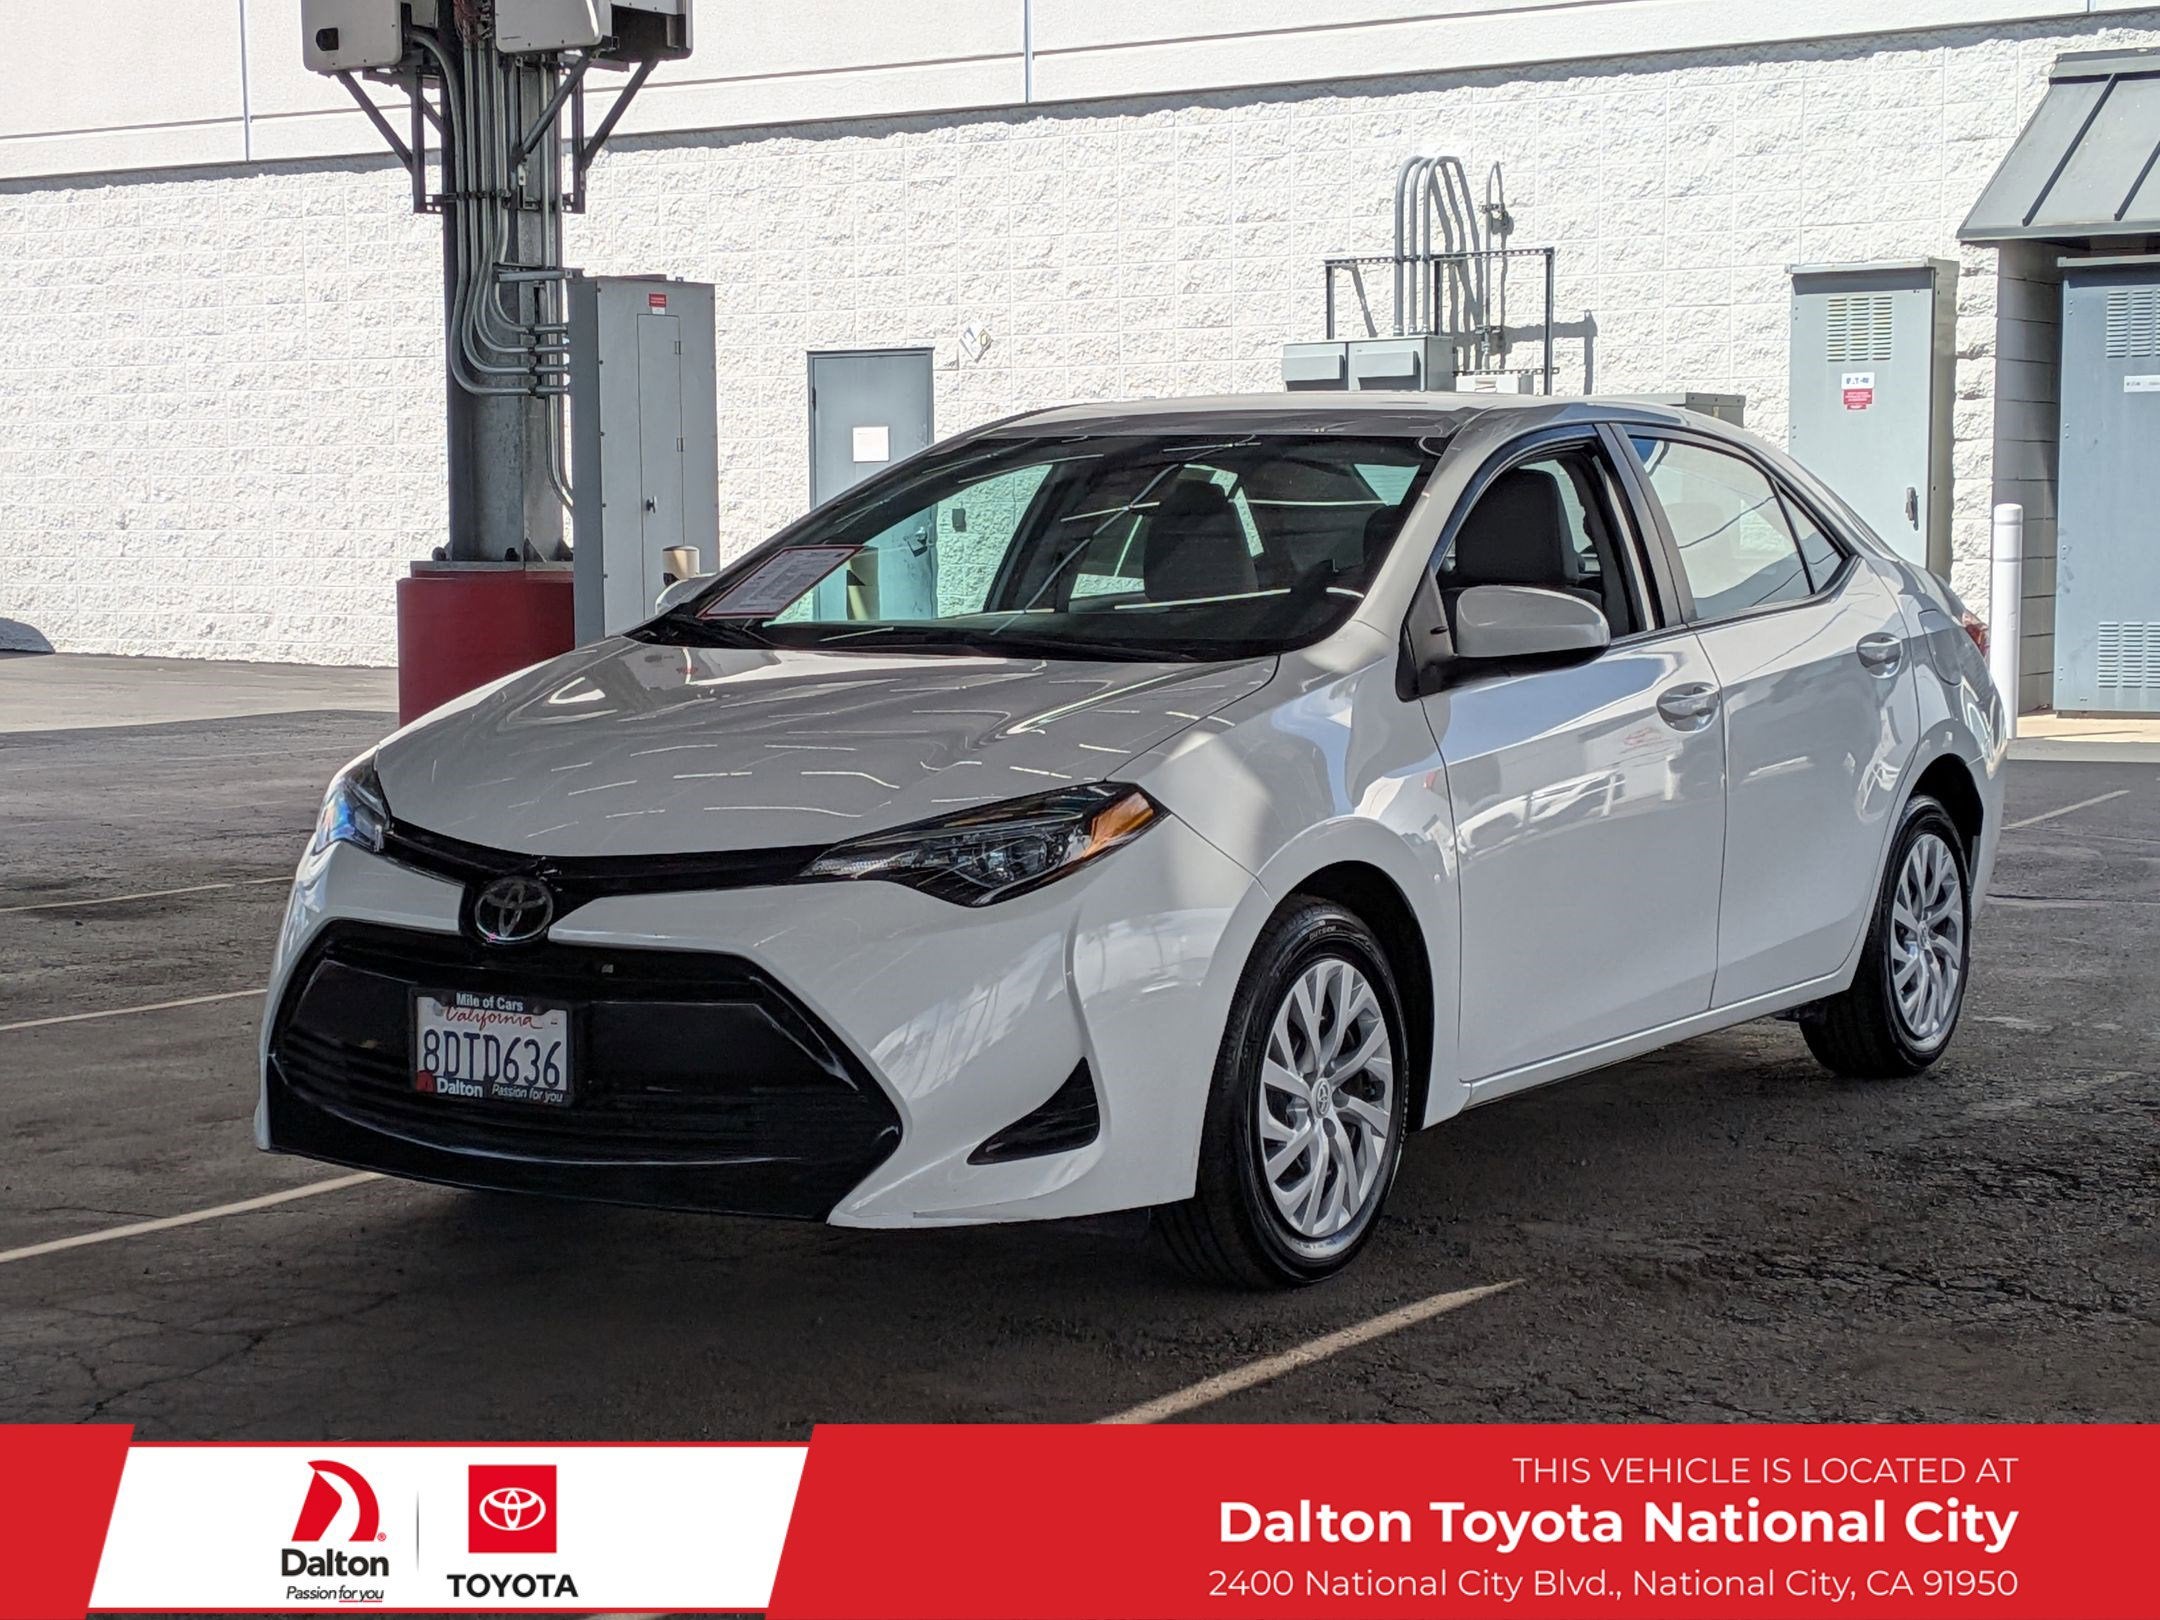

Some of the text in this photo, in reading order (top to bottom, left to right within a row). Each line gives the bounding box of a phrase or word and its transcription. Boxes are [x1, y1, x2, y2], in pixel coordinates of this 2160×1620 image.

[456, 992, 523, 1012] Mile of Cars
[444, 1006, 543, 1031] California
[424, 1028, 562, 1089] 8DTD636
[436, 1077, 564, 1103] Dalton Passion for you
